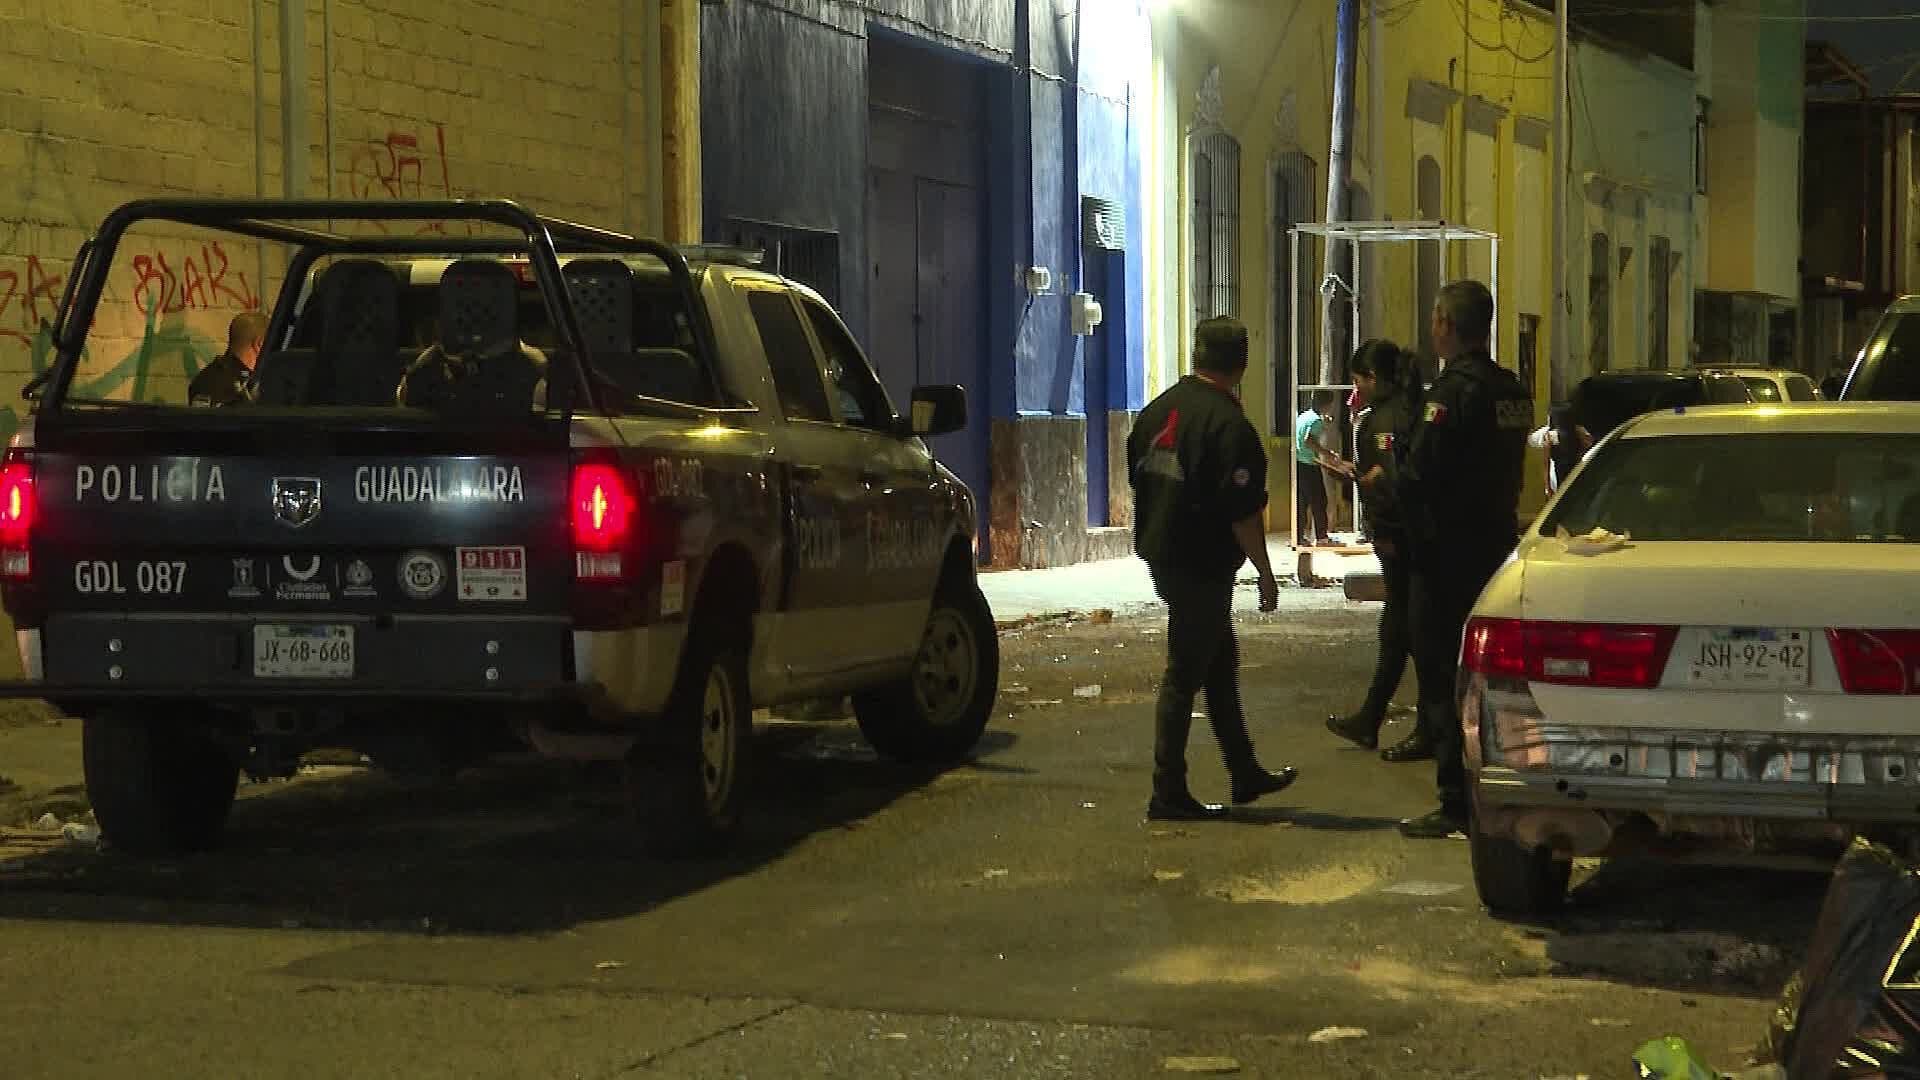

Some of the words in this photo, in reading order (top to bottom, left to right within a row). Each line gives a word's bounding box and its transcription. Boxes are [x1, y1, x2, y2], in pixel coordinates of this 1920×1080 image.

[355, 466, 524, 501] GUADALAARA
[464, 551, 516, 569] 911
[75, 560, 127, 594] GDL
[137, 560, 187, 594] 087
[259, 639, 351, 663] JX-68-668
[1694, 641, 1804, 669] JSH-92-42
